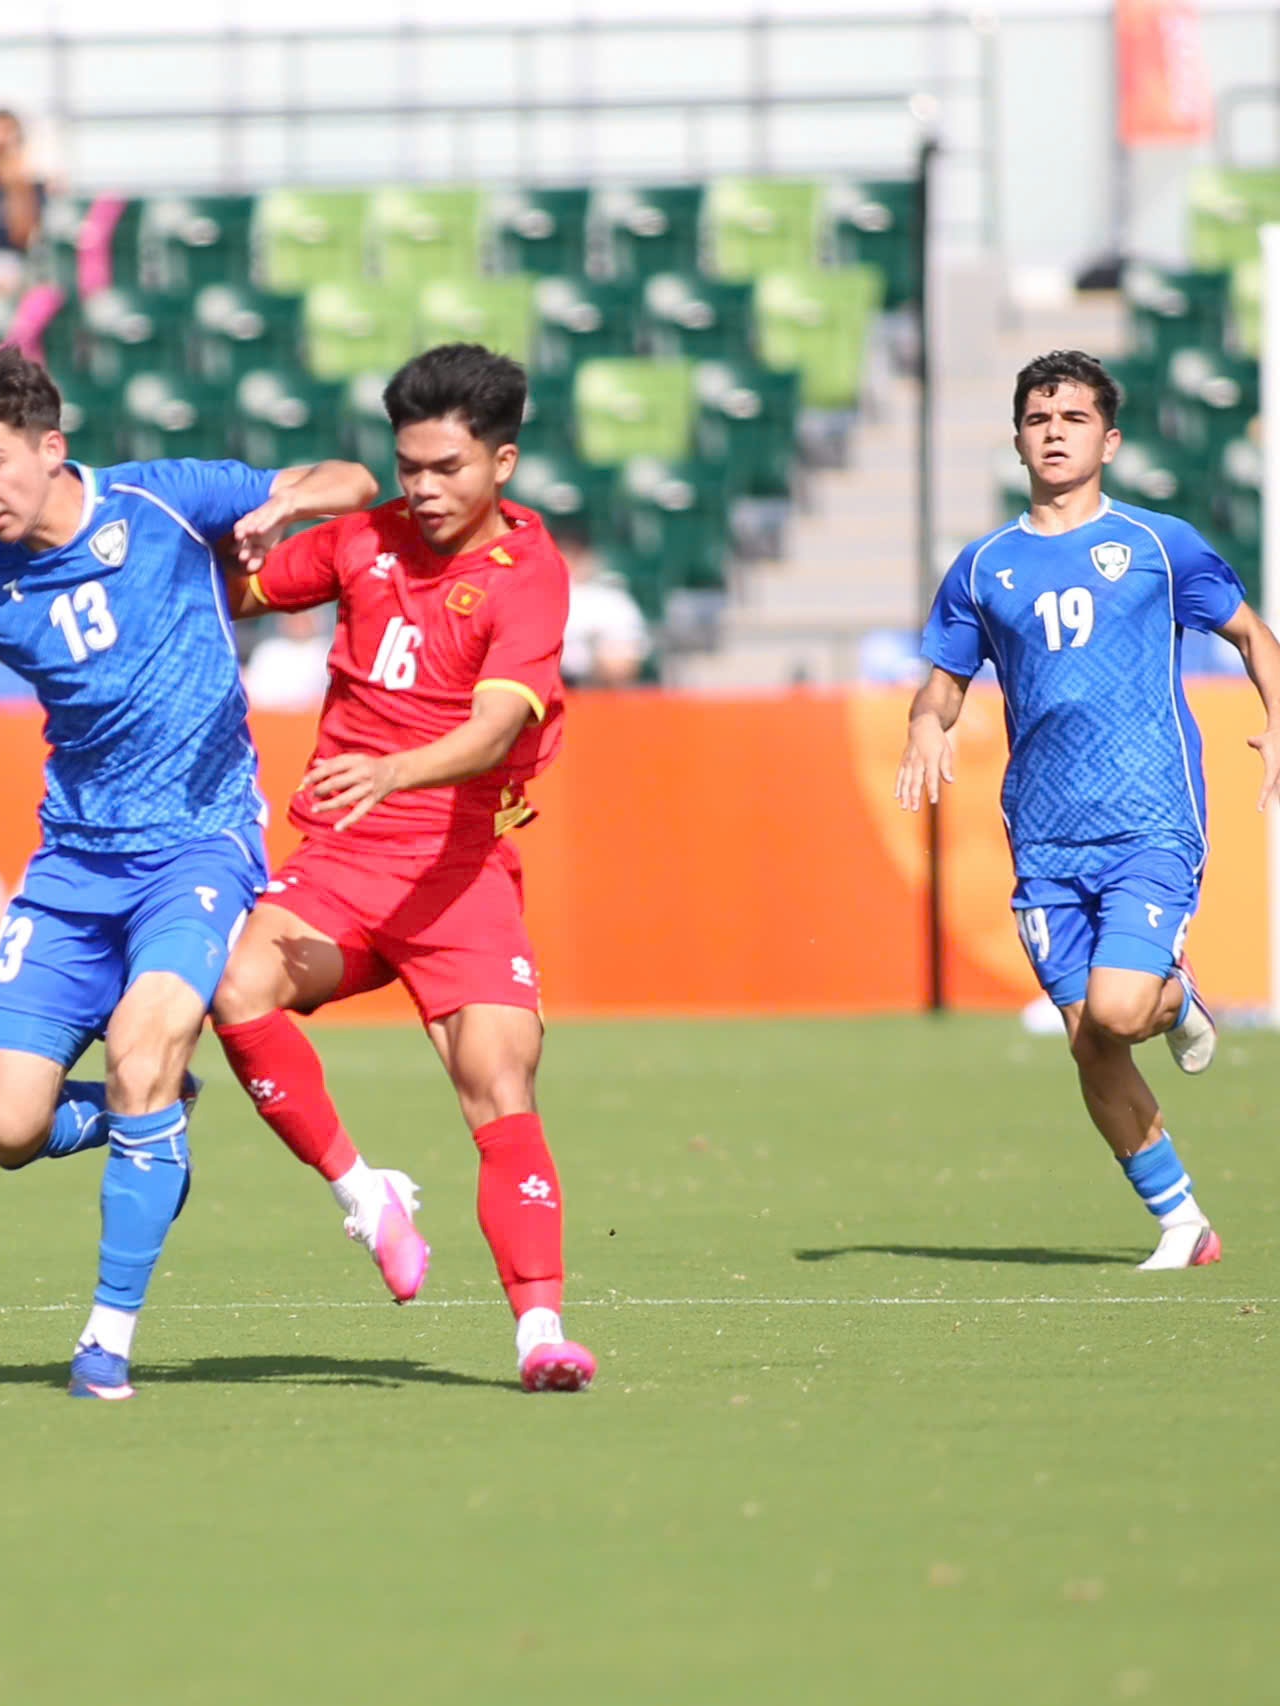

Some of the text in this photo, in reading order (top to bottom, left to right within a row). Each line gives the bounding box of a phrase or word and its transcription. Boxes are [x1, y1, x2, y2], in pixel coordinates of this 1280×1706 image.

[49, 580, 117, 664] 13
[368, 616, 423, 690] 16
[1034, 586, 1094, 651] 19
